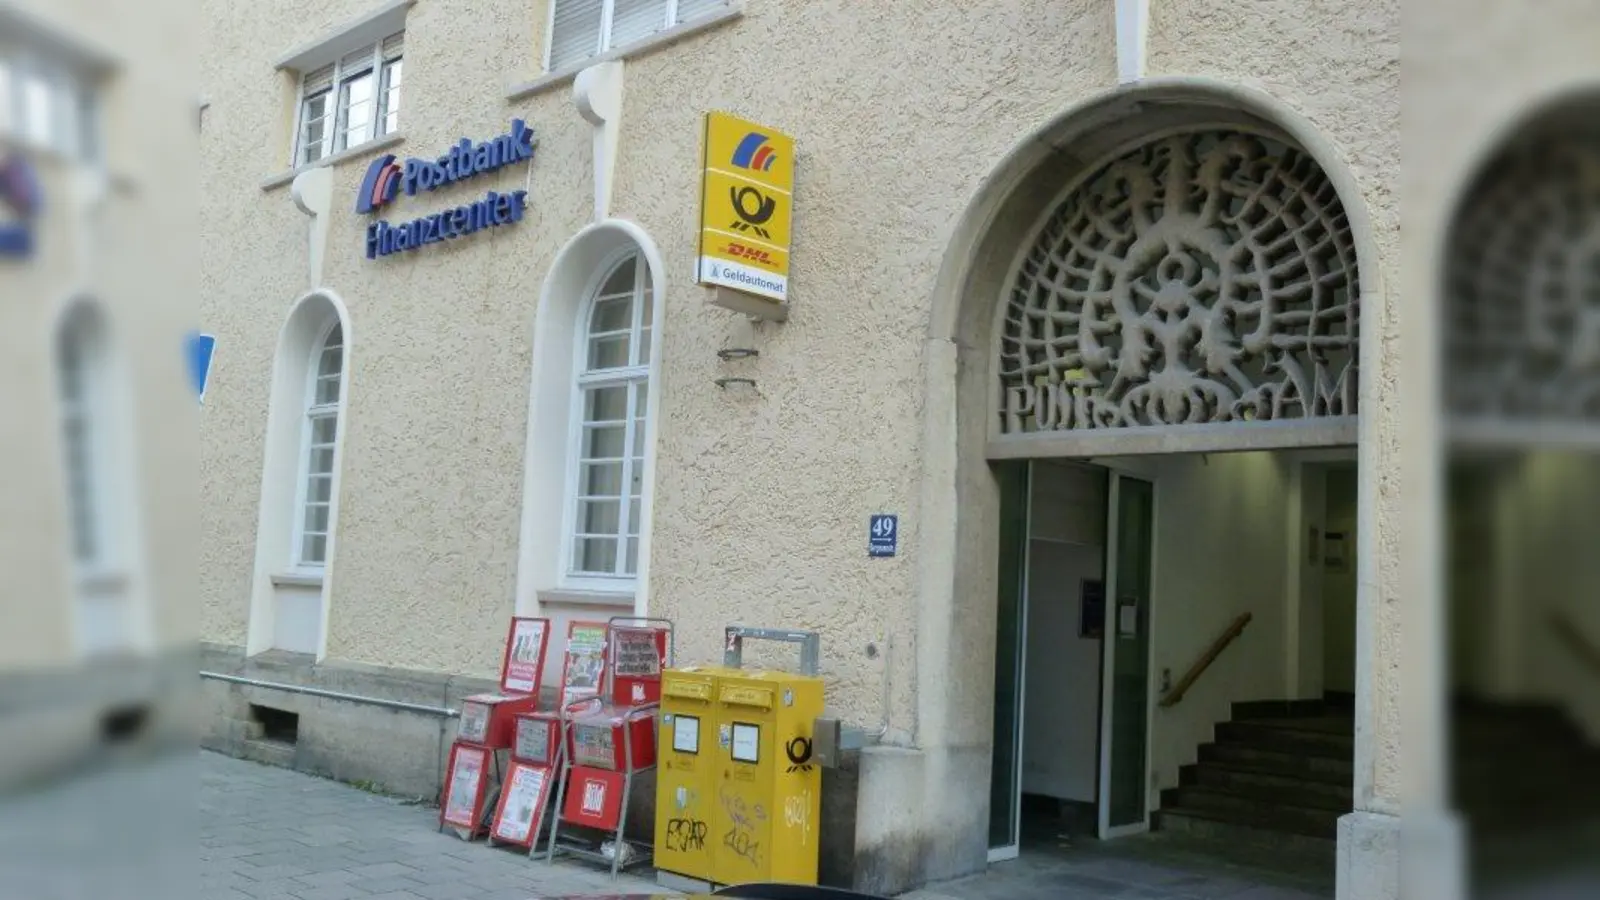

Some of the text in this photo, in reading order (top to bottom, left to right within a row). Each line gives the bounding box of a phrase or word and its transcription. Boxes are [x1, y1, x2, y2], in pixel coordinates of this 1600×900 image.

[404, 118, 534, 196] Postbank
[366, 190, 527, 260] Finanzcenter
[728, 243, 770, 264] DHL
[722, 267, 785, 294] Geldautomat
[872, 516, 893, 536] 49
